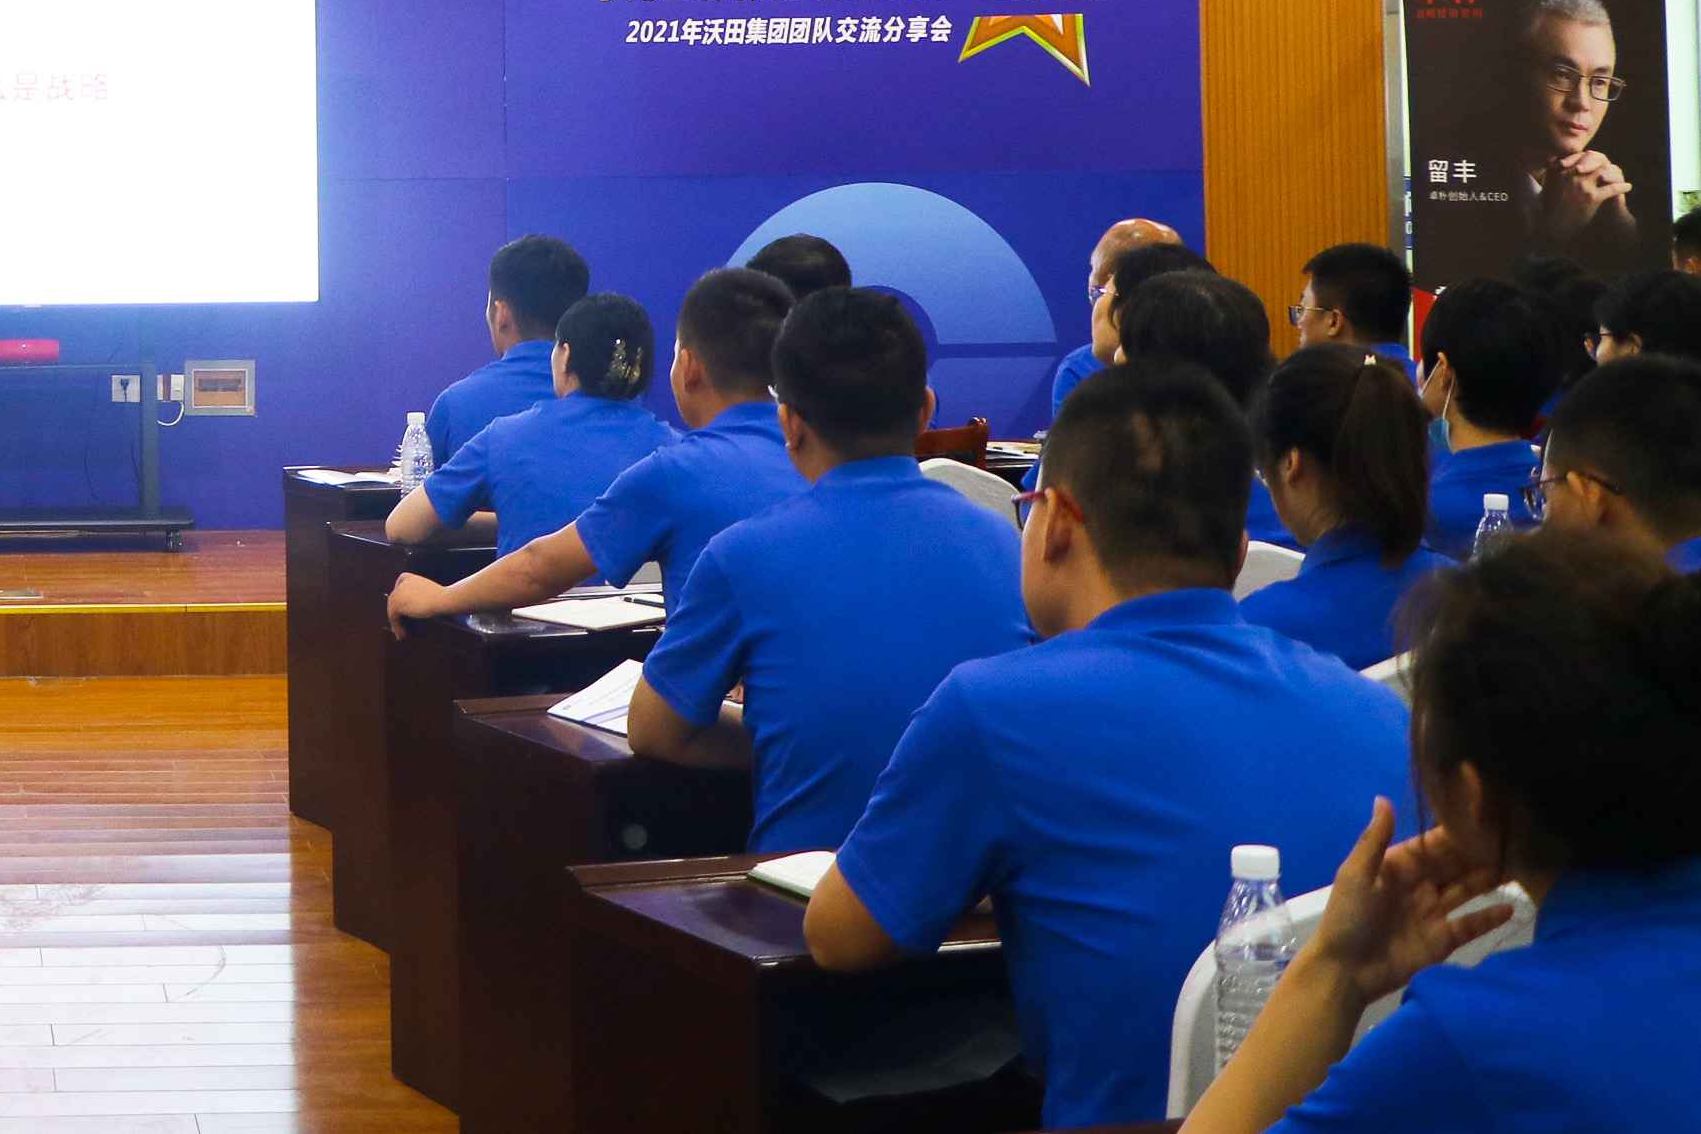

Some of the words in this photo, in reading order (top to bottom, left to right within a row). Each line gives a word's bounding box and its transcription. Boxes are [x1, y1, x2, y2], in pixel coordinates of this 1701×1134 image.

[625, 15, 953, 46] 2021年沃田集团团队交流分享会
[1428, 159, 1477, 184] 留丰
